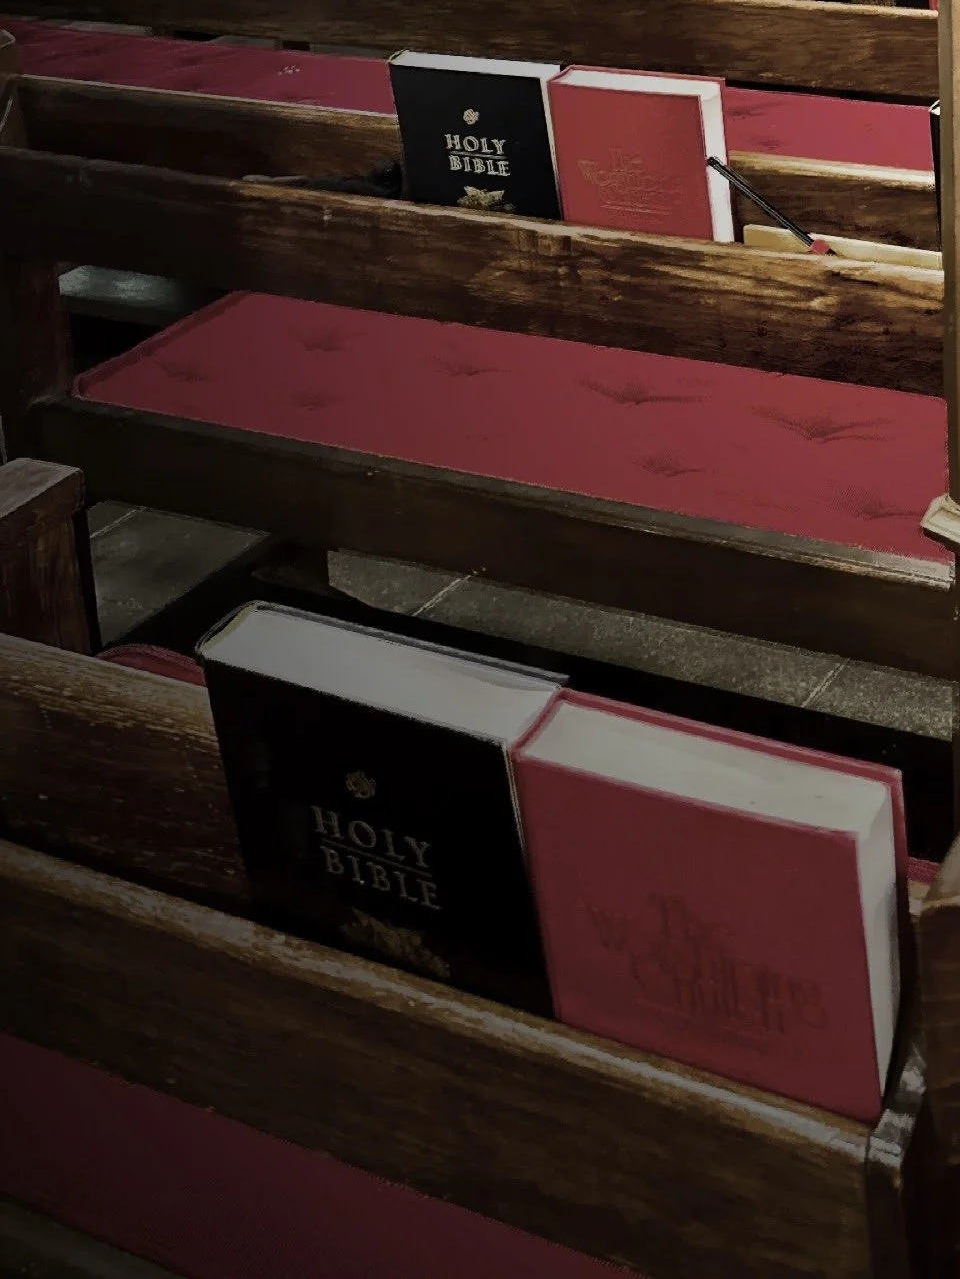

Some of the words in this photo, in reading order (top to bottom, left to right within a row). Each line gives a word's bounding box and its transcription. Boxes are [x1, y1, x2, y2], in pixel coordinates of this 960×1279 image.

[444, 133, 507, 157] HOLY
[449, 154, 511, 177] BIBLE
[310, 804, 434, 870] HOLY
[322, 845, 444, 911] BIBLE
